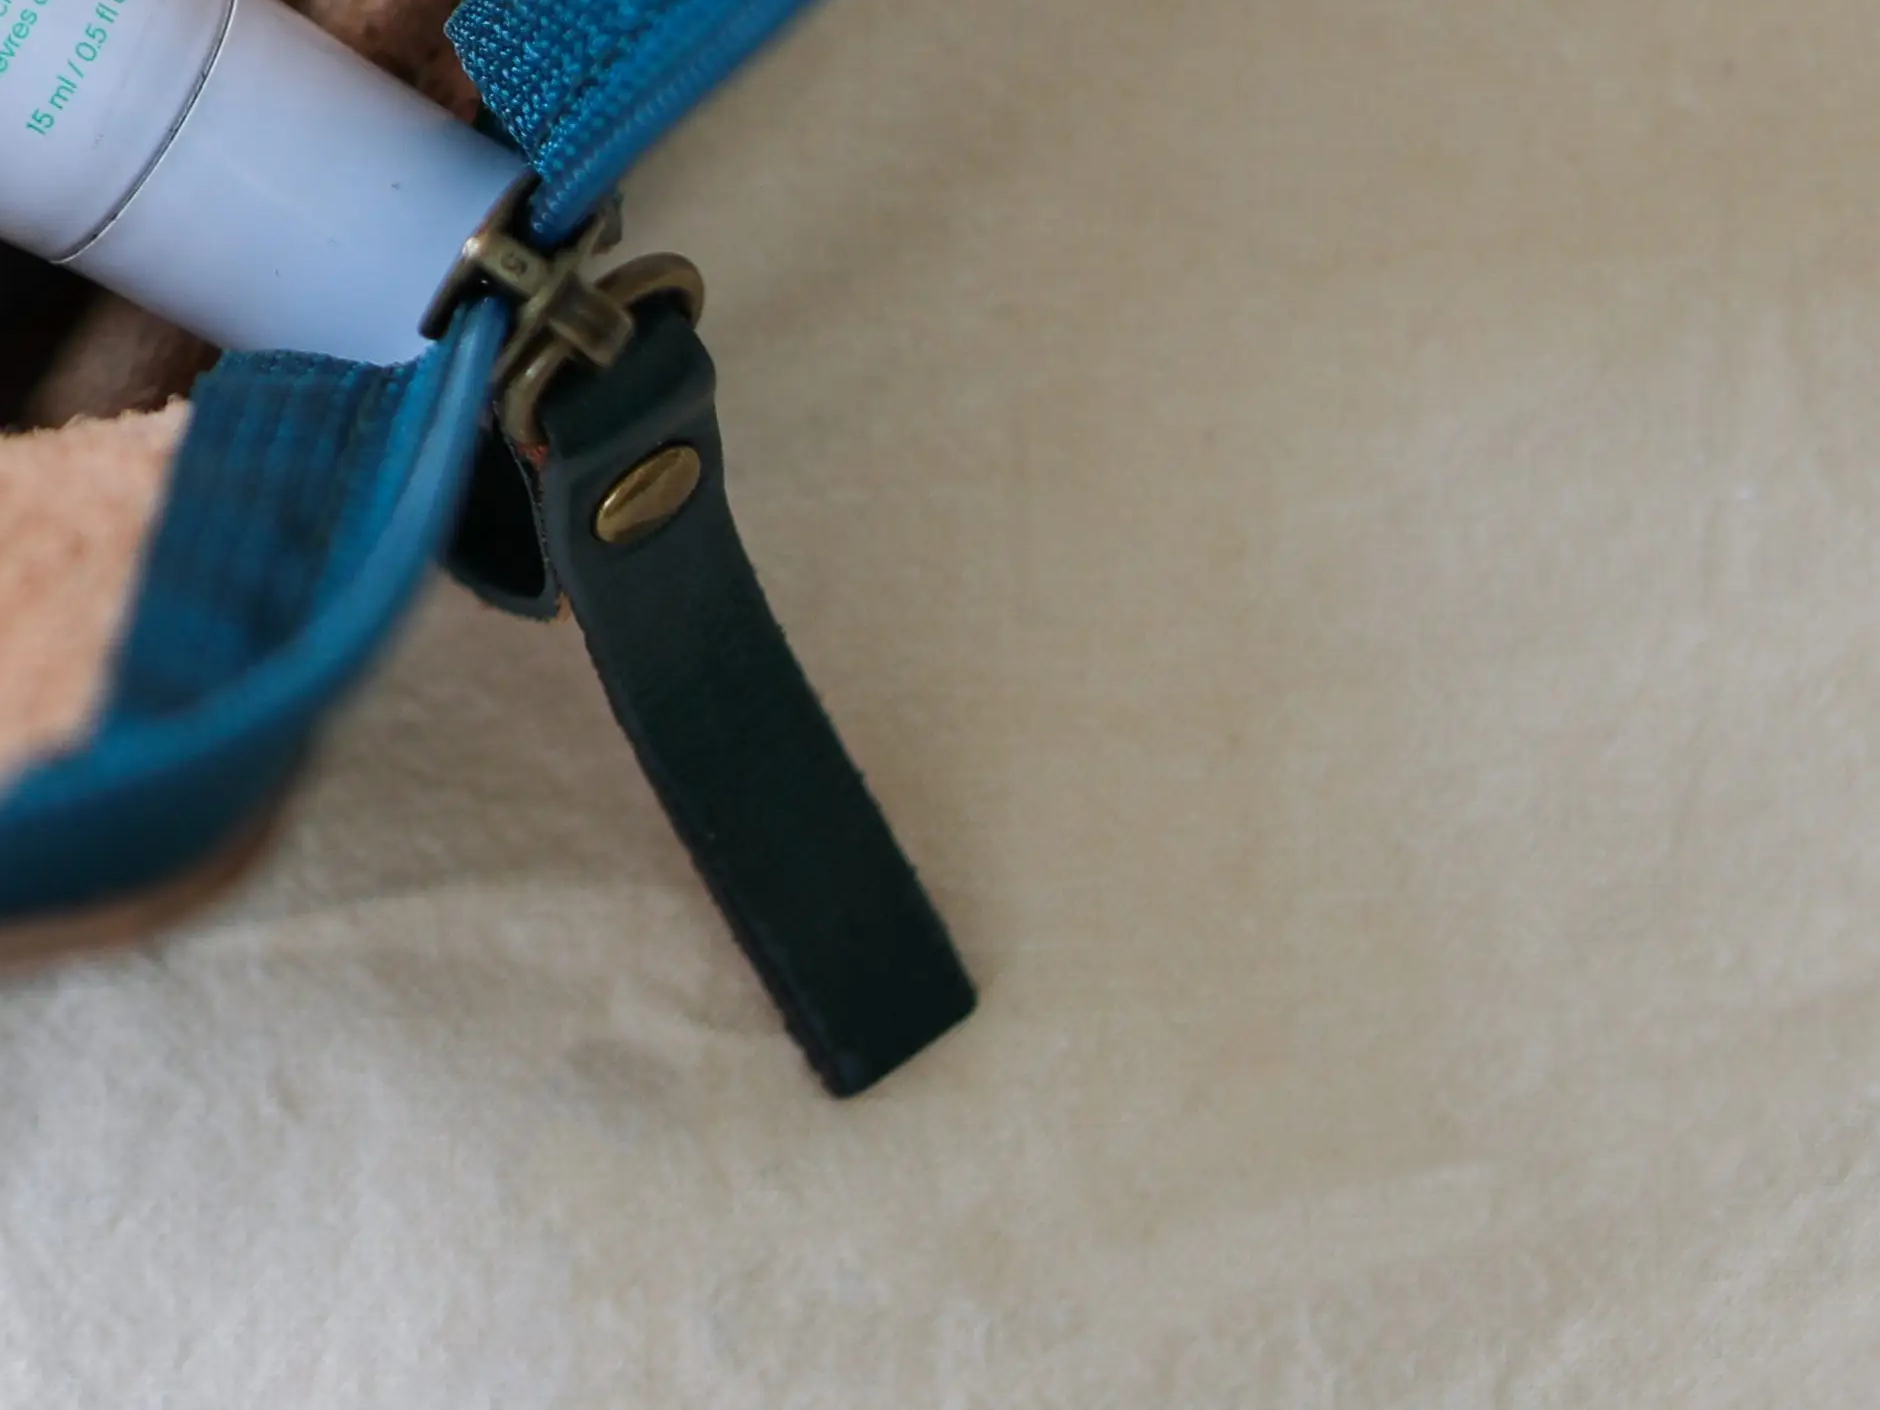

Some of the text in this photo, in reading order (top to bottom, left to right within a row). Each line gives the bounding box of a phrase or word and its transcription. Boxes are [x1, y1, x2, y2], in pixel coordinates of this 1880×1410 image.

[27, 108, 55, 135] 15
[49, 75, 78, 108] ml
[67, 59, 84, 78] /
[76, 24, 108, 62] 0.5
